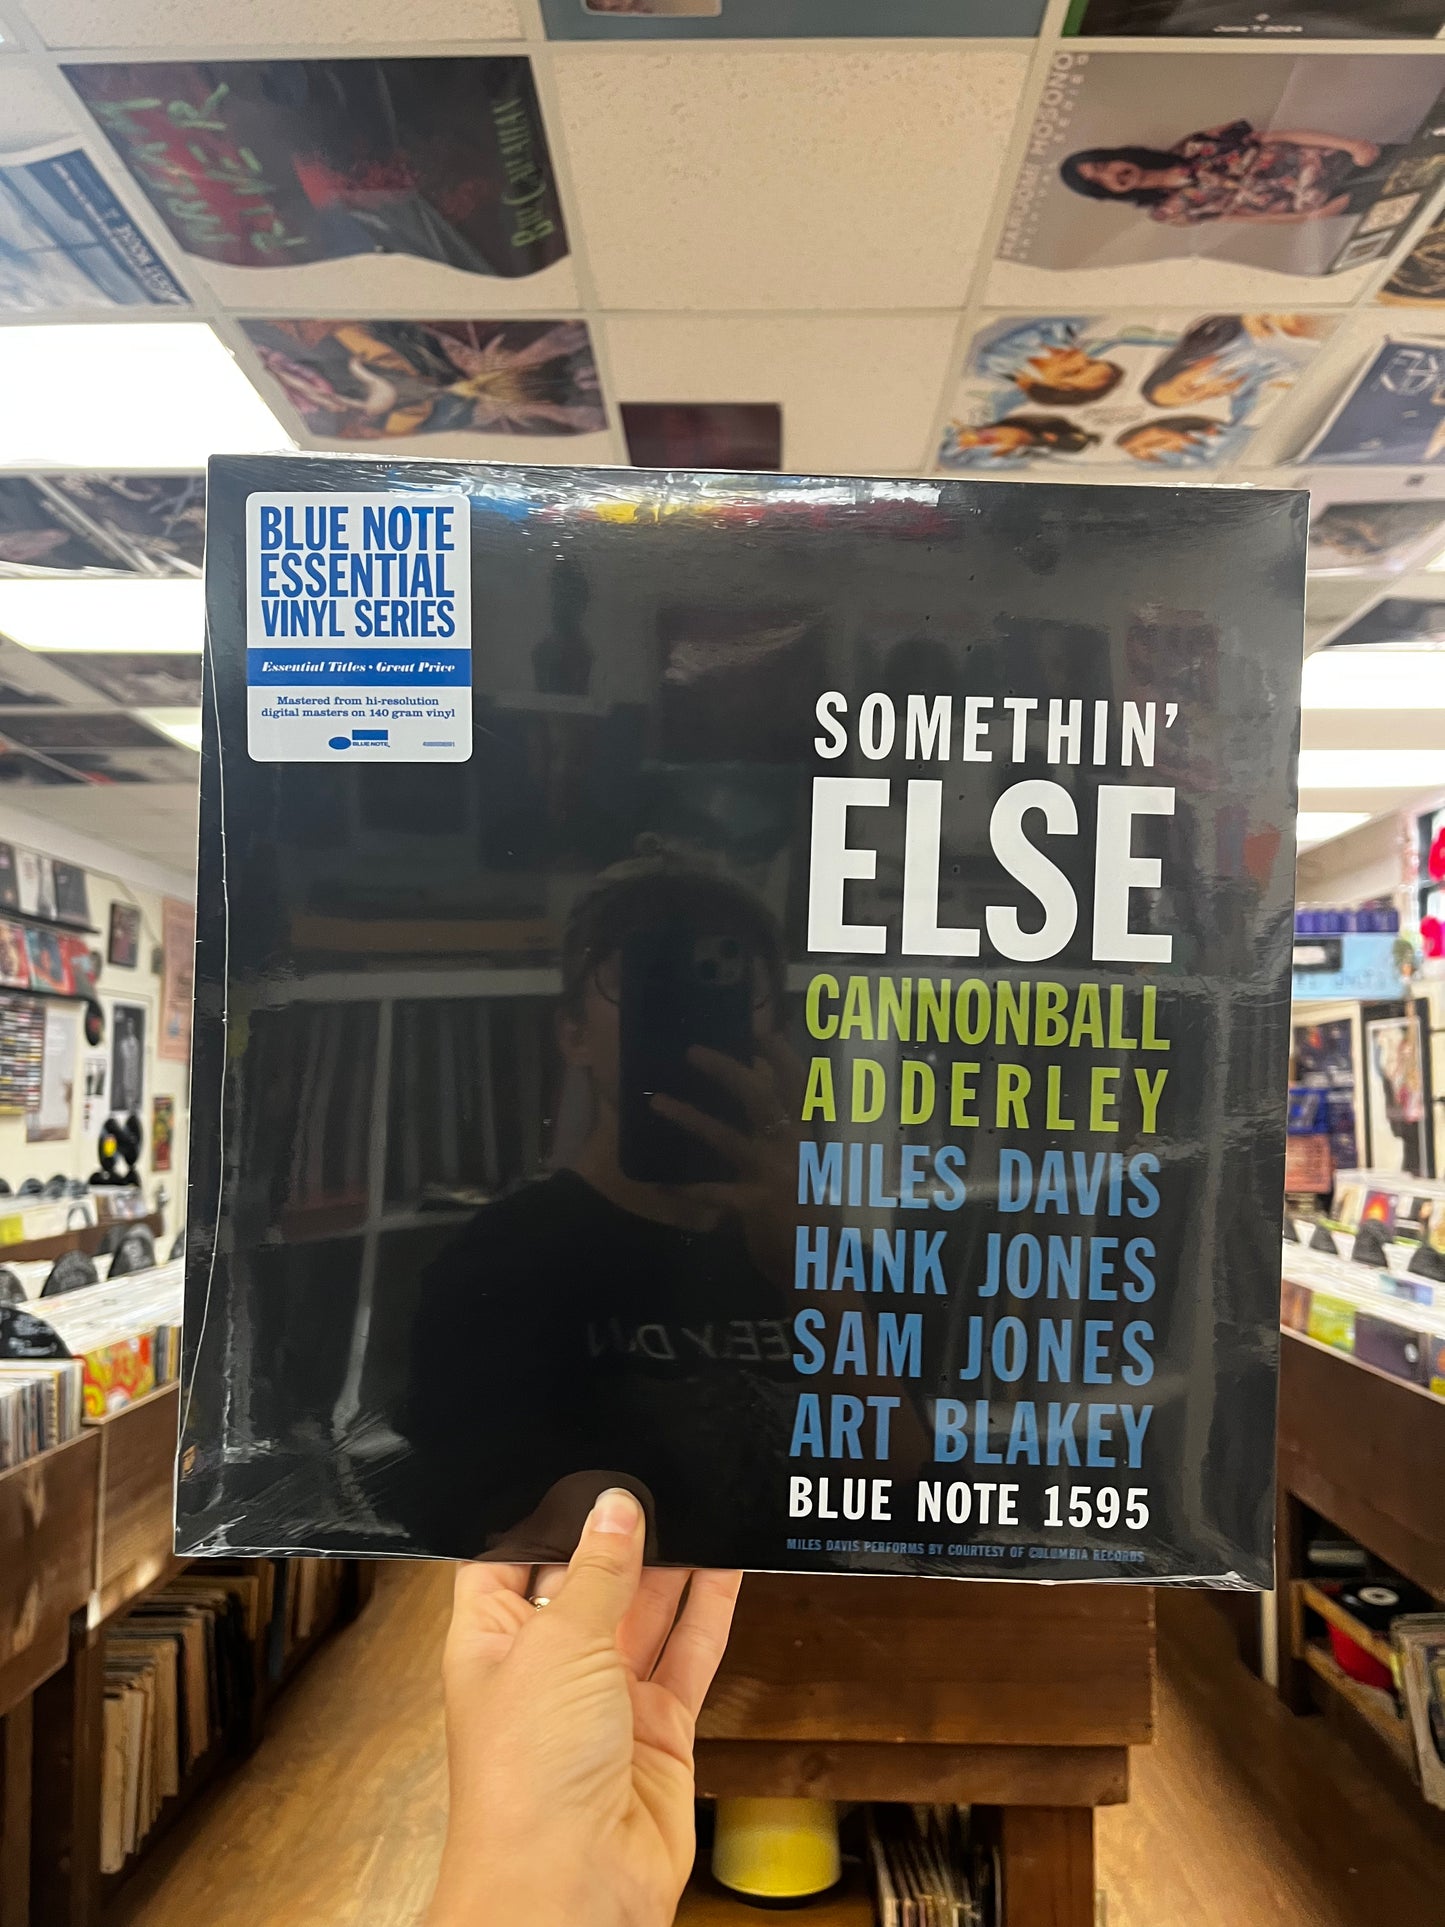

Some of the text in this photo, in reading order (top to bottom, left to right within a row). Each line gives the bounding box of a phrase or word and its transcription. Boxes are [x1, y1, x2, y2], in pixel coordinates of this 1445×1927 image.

[260, 505, 455, 551] BLUE NOTE
[260, 552, 455, 598] ESSENTIAL
[261, 600, 456, 638] VINYL SERIES
[261, 661, 456, 673] Essential Titles Great Price
[261, 708, 456, 720] digital masters on 140 gram vinyl
[277, 696, 439, 706] Mastered from hi-resolution
[807, 776, 1176, 963] ELSE
[805, 973, 1170, 1050] CANNONBALL
[801, 1057, 1168, 1133] ADDERLEY
[798, 1141, 1161, 1218] MILES DAVIS
[794, 1226, 1156, 1302] HANK JONES
[793, 1309, 1154, 1386] SAM JONES
[789, 1393, 1153, 1468] ART BLAKEY
[789, 1476, 1149, 1530] BLUE NOTE 1595
[786, 1538, 822, 1551] MILES
[826, 1539, 860, 1552] DAVIS
[863, 1541, 925, 1555] PERFORMS
[928, 1543, 944, 1555] BY
[947, 1543, 1005, 1558] COURTESY
[1009, 1546, 1025, 1558] OF
